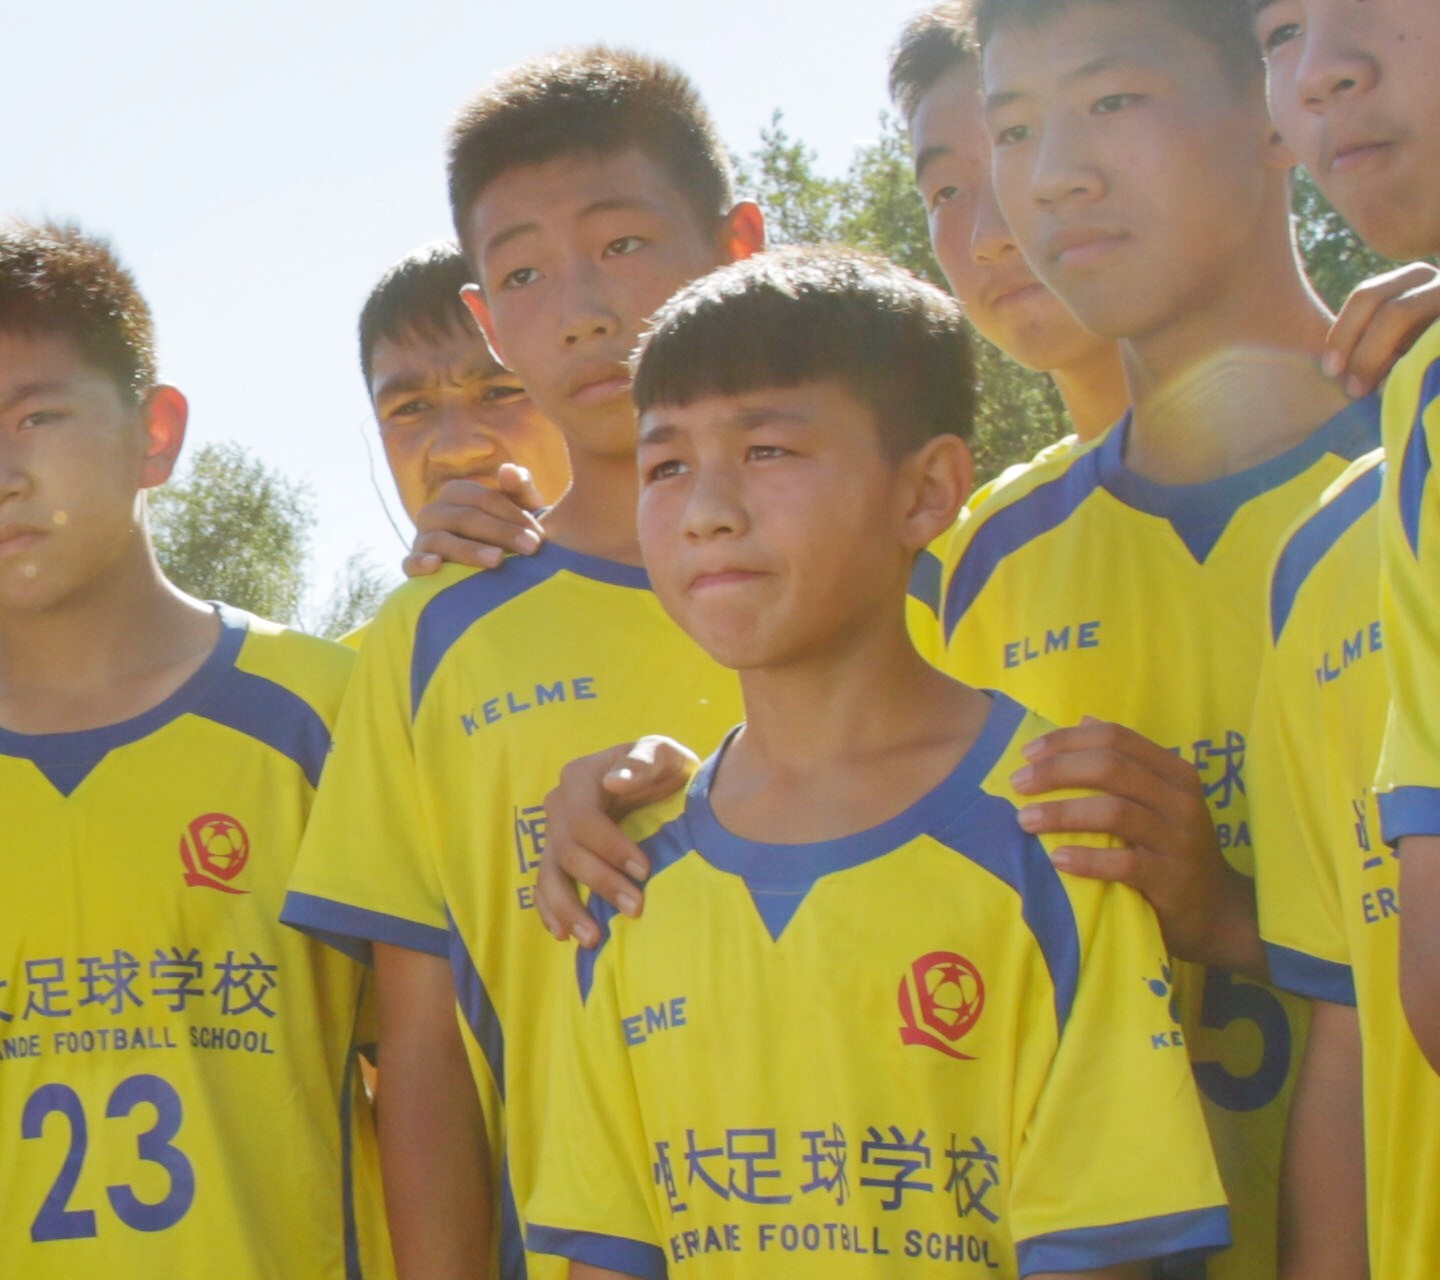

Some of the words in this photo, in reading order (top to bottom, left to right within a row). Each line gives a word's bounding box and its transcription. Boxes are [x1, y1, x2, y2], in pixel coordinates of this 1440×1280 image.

[461, 677, 598, 737] KELME
[54, 1026, 178, 1054] FOOTBALL
[189, 1026, 275, 1054] SCHOOL
[21, 1073, 196, 1243] 23
